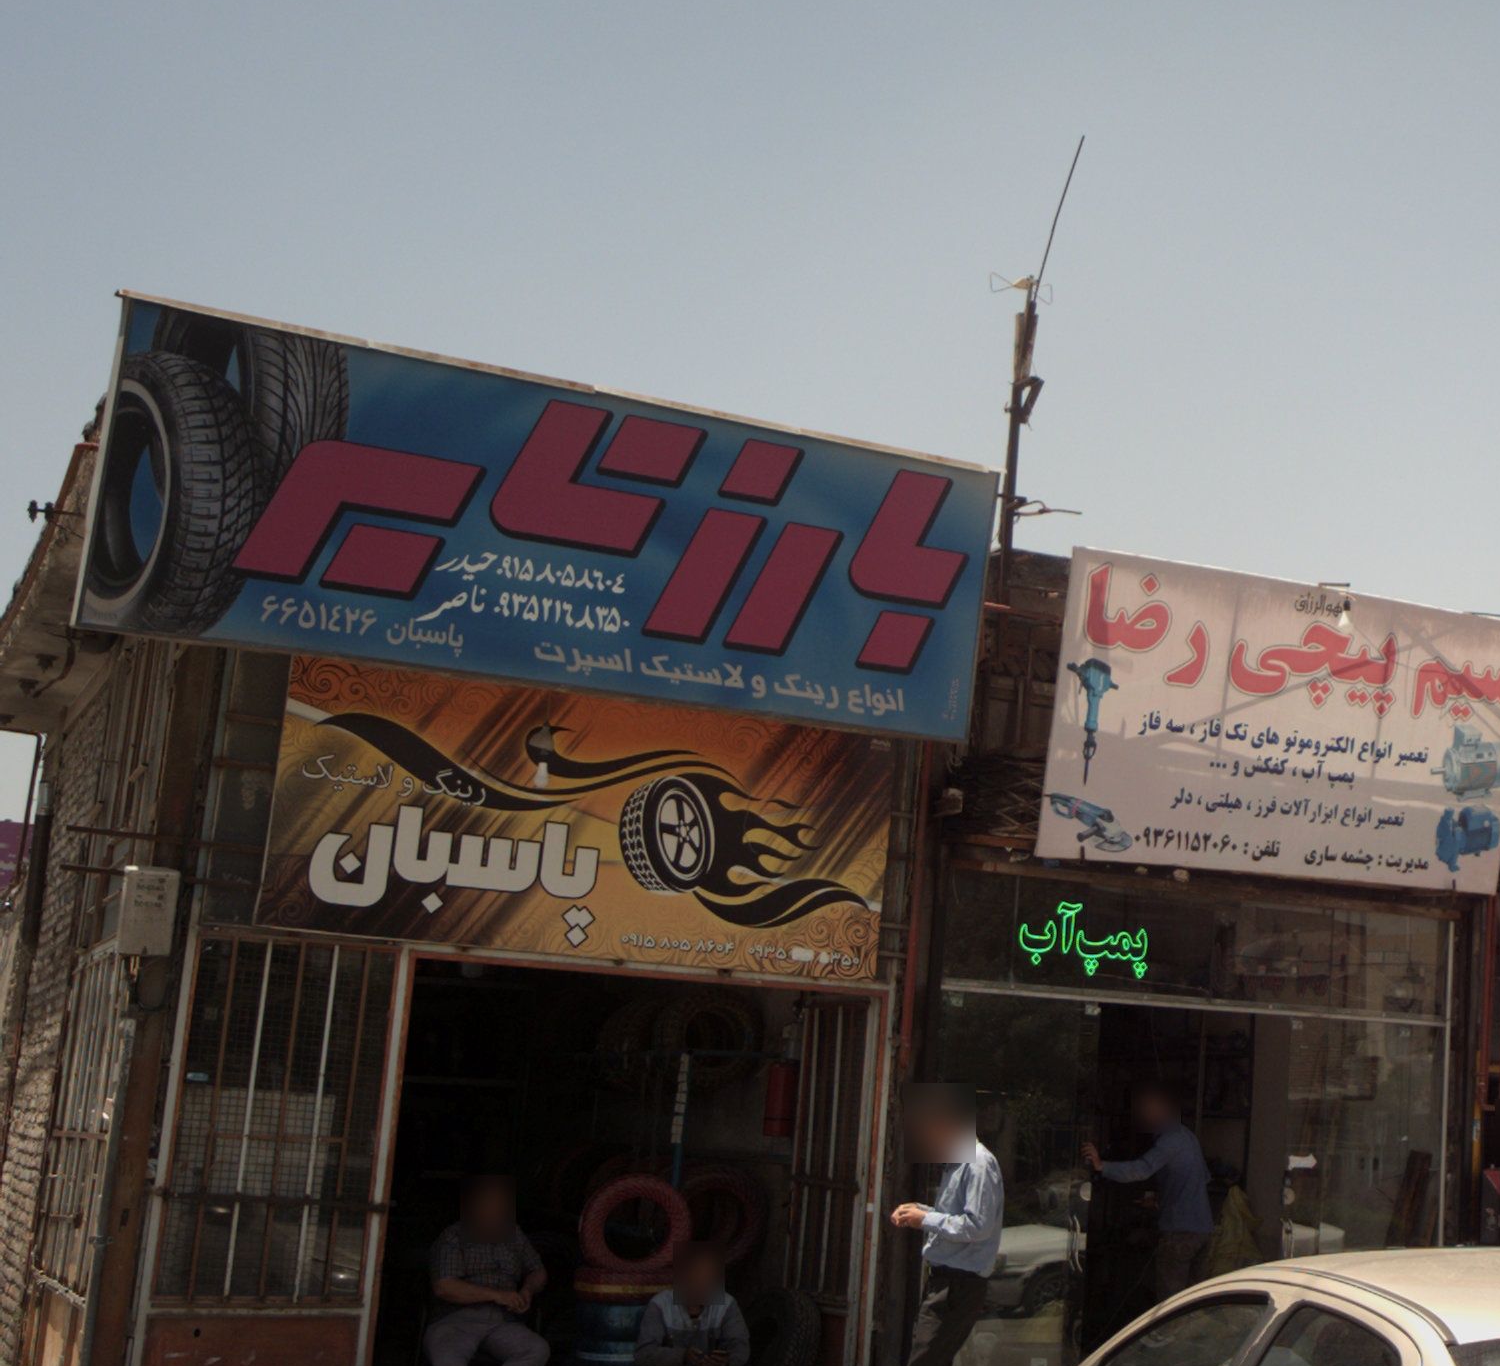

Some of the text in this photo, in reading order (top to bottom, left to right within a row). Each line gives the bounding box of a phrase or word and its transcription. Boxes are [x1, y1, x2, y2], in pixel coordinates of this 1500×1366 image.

[434, 551, 499, 581] حیدر
[415, 585, 488, 622] ناصر
[1083, 561, 1211, 688] رضا
[386, 619, 464, 658] پاسبان
[534, 642, 633, 676] اسپرت
[1228, 619, 1398, 718] پیچی
[640, 655, 745, 688] لاستیک
[752, 675, 767, 699] و
[847, 684, 905, 716] انواع
[1137, 710, 1162, 735] فاز
[1165, 718, 1186, 733] سه
[1198, 718, 1222, 744] فاز
[1225, 722, 1249, 741] تک
[1250, 726, 1280, 749] های
[1357, 741, 1393, 764] انواع
[1394, 746, 1429, 766] تعمیر
[301, 754, 395, 793] لاستیک
[1230, 760, 1240, 777] و
[1243, 755, 1289, 778] کفکش
[1302, 760, 1325, 784] آب
[398, 775, 416, 798] و
[1327, 769, 1355, 790] پمپ
[1170, 787, 1193, 810] دلر
[1205, 792, 1243, 813] هیلتی
[1254, 796, 1277, 819] فرز
[1340, 806, 1372, 827] انواع
[1374, 811, 1406, 830] تعمیر
[1251, 839, 1281, 862] تلفن
[308, 803, 600, 948] پاسبان
[1385, 857, 1429, 874] مدیریت
[1019, 901, 1149, 980] پمپ آب
